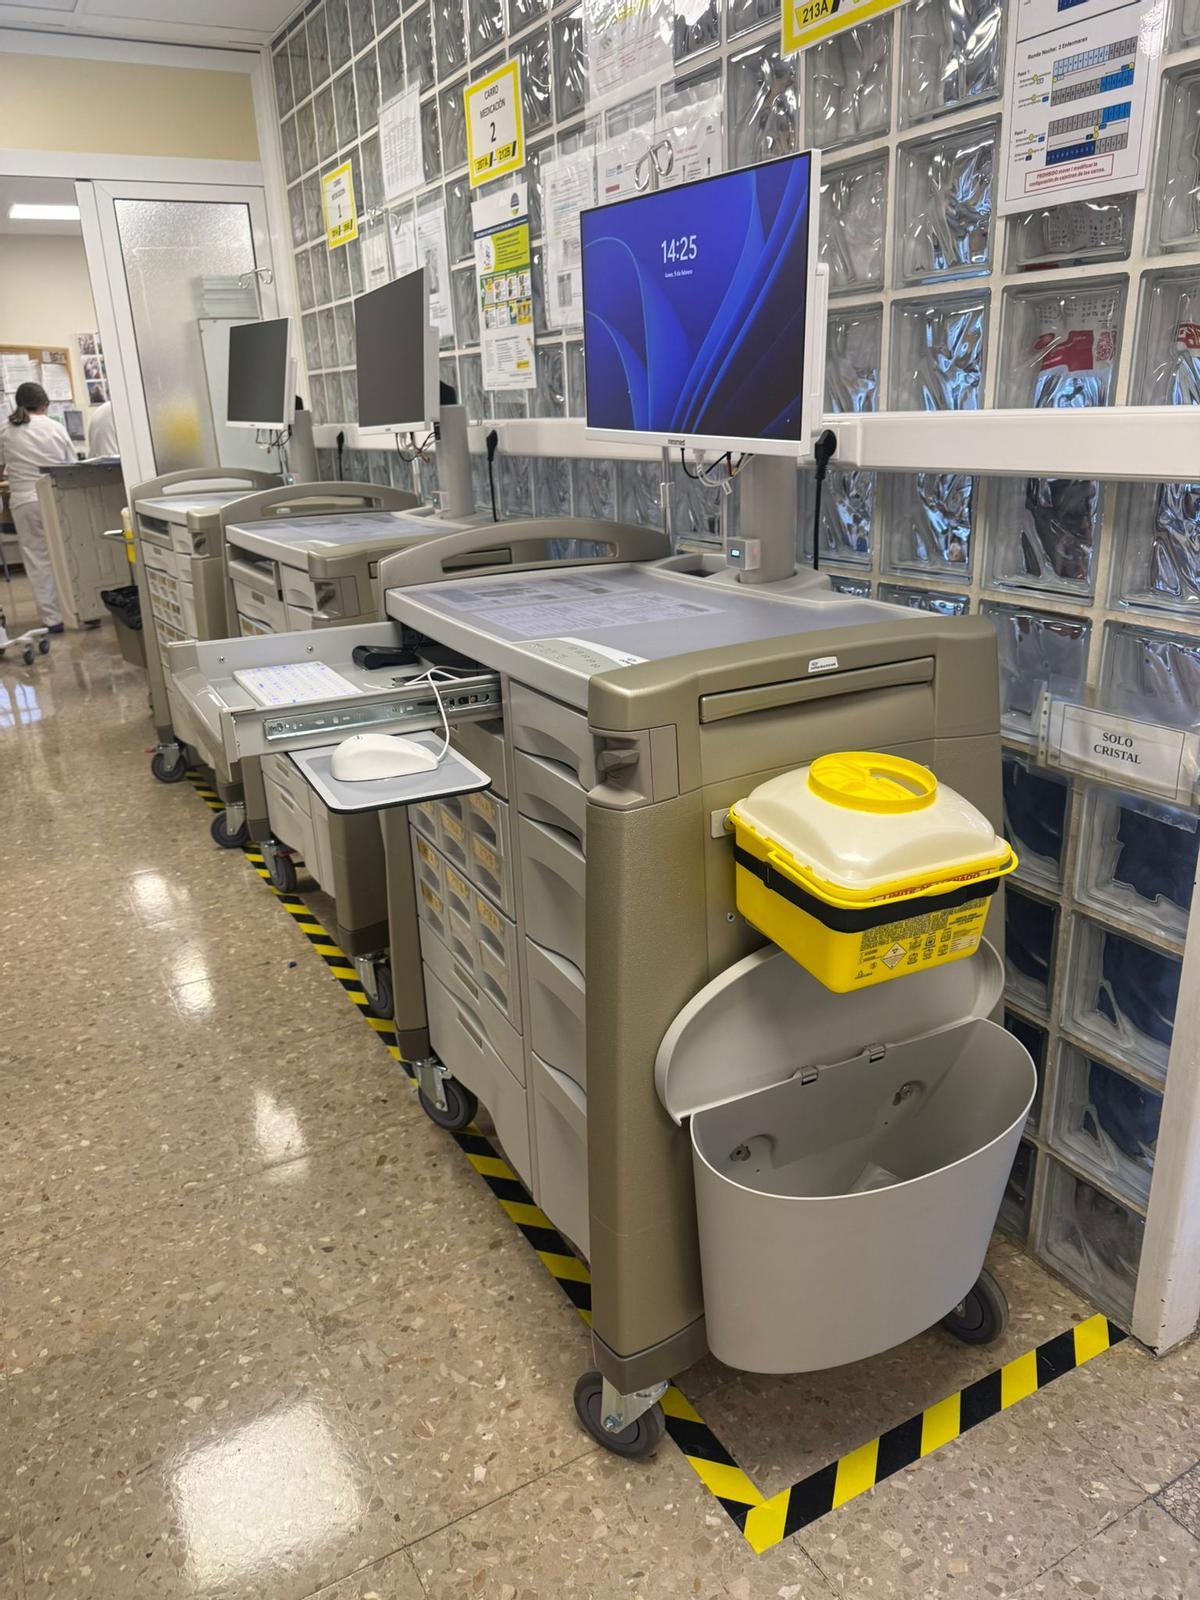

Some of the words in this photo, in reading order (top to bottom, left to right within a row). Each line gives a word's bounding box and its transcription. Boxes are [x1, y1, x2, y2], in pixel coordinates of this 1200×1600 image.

[803, 0, 829, 24] 213A
[484, 84, 499, 100] CARRO
[480, 98, 506, 119] MEDICACIÓN
[490, 121, 496, 144] 2
[661, 234, 697, 264] 14:25
[1102, 731, 1133, 748] SOLO
[1093, 743, 1142, 765] CRISTAL
